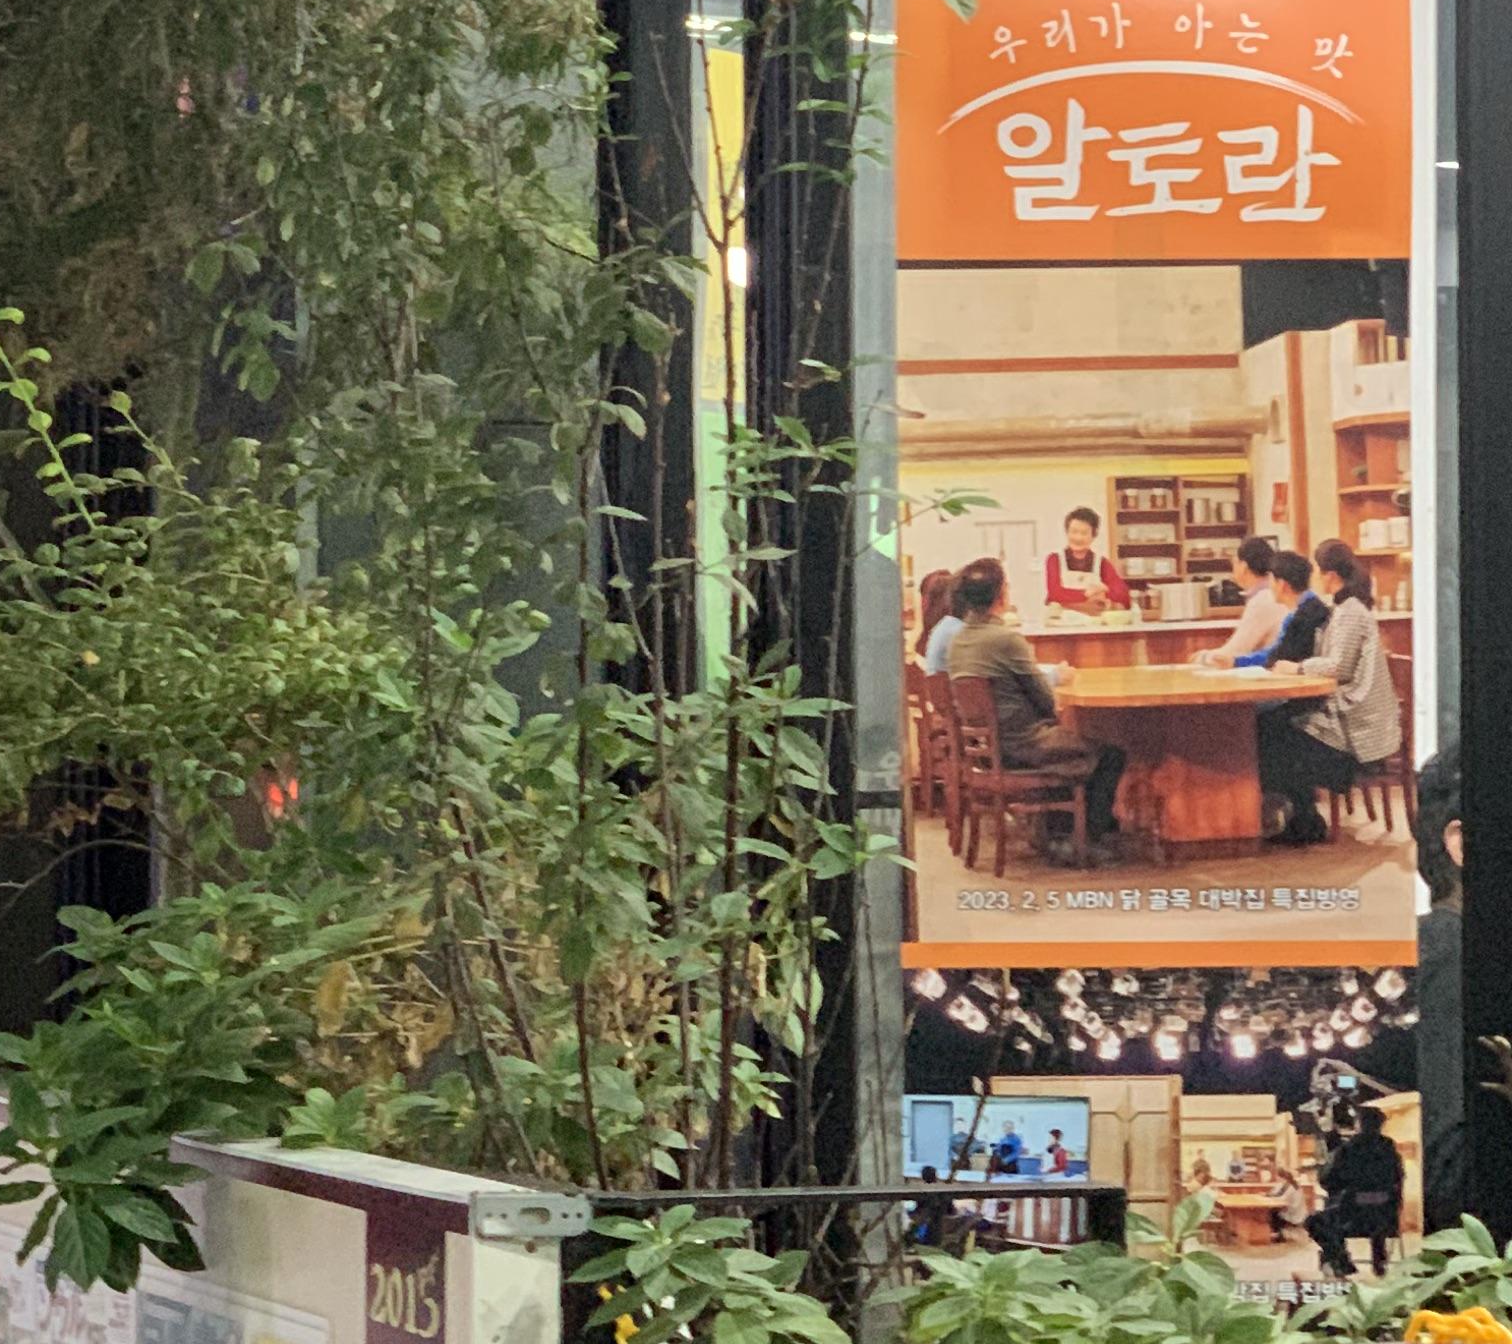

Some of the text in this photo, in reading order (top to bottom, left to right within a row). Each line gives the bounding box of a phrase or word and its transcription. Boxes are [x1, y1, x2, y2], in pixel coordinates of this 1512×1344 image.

[989, 2, 1354, 79] 우리가 아는 맛
[996, 97, 1343, 224] 알토란
[1046, 889, 1060, 910] 5
[1064, 889, 1114, 910] MBN
[1119, 888, 1140, 911] 닭
[1147, 888, 1193, 911] 골목
[1199, 888, 1265, 911] 대박집
[1271, 887, 1361, 911] 특집방영
[369, 1262, 440, 1339] 2015
